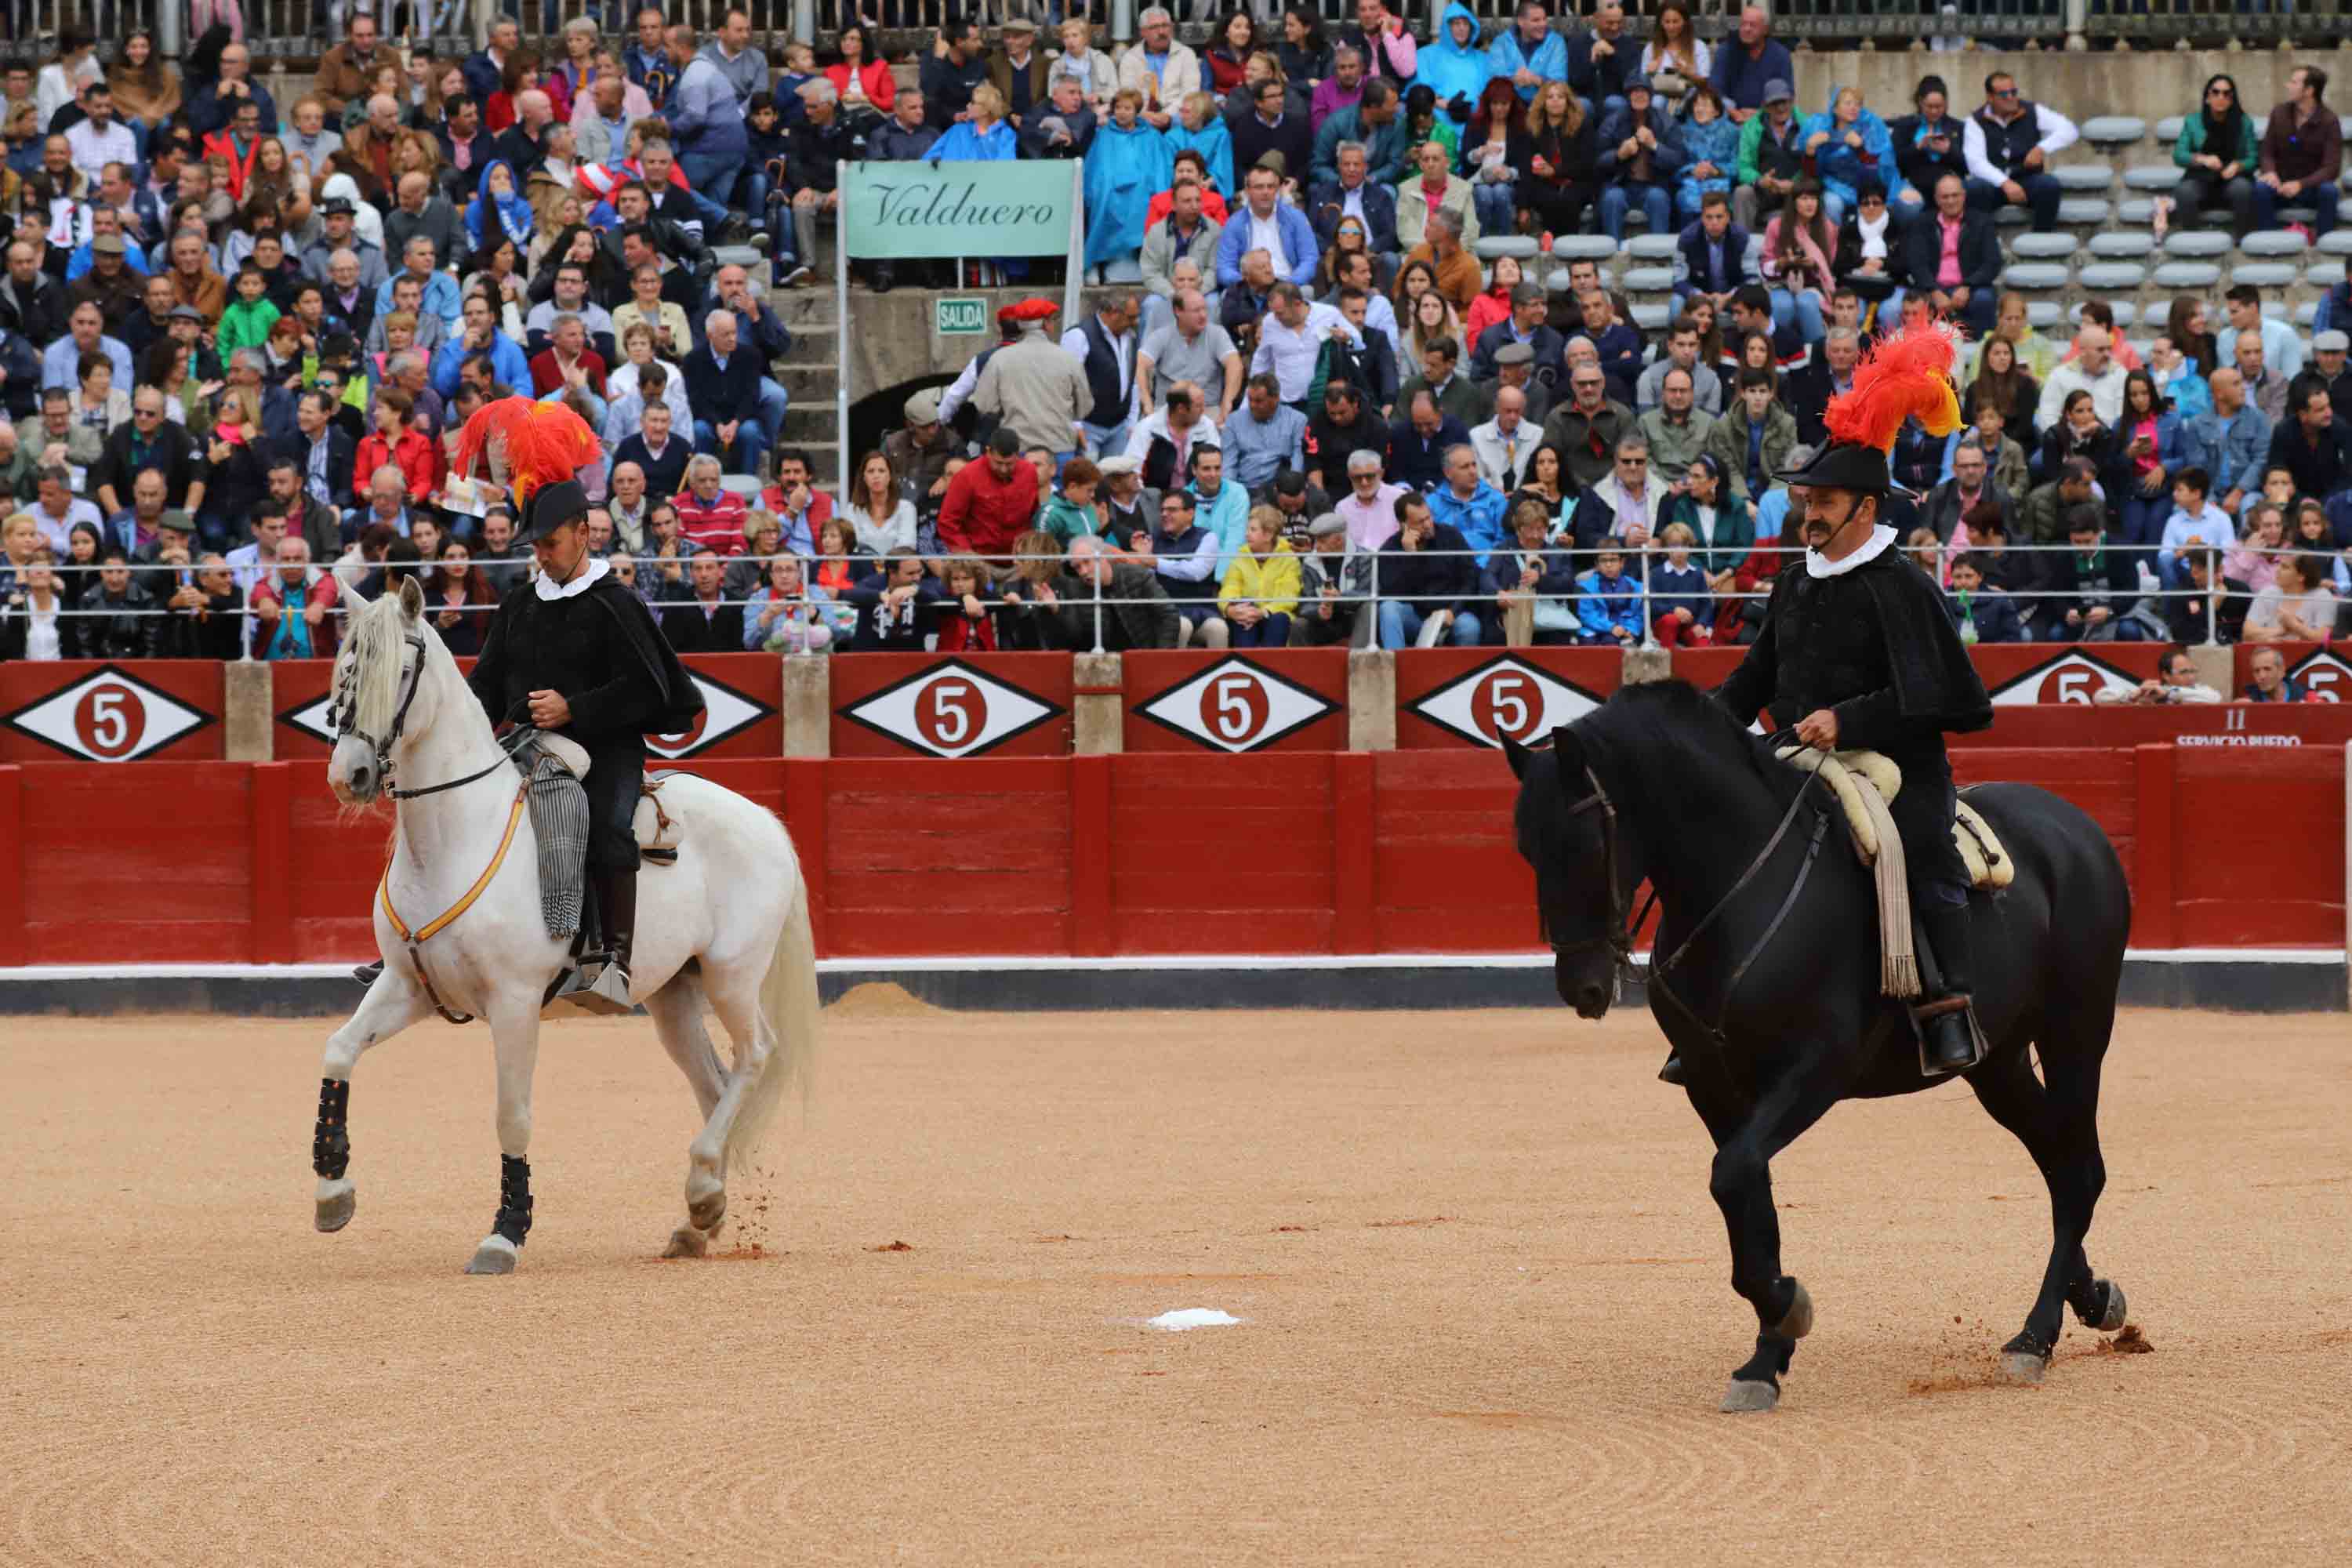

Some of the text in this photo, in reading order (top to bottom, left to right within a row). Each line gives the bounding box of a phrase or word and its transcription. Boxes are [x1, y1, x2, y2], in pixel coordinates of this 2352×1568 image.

[868, 181, 1054, 227] Valduero
[940, 304, 984, 328] SALIDA
[93, 692, 127, 748] 5
[935, 685, 969, 742] 5
[1218, 678, 1252, 739] 5
[1492, 678, 1528, 732] 5
